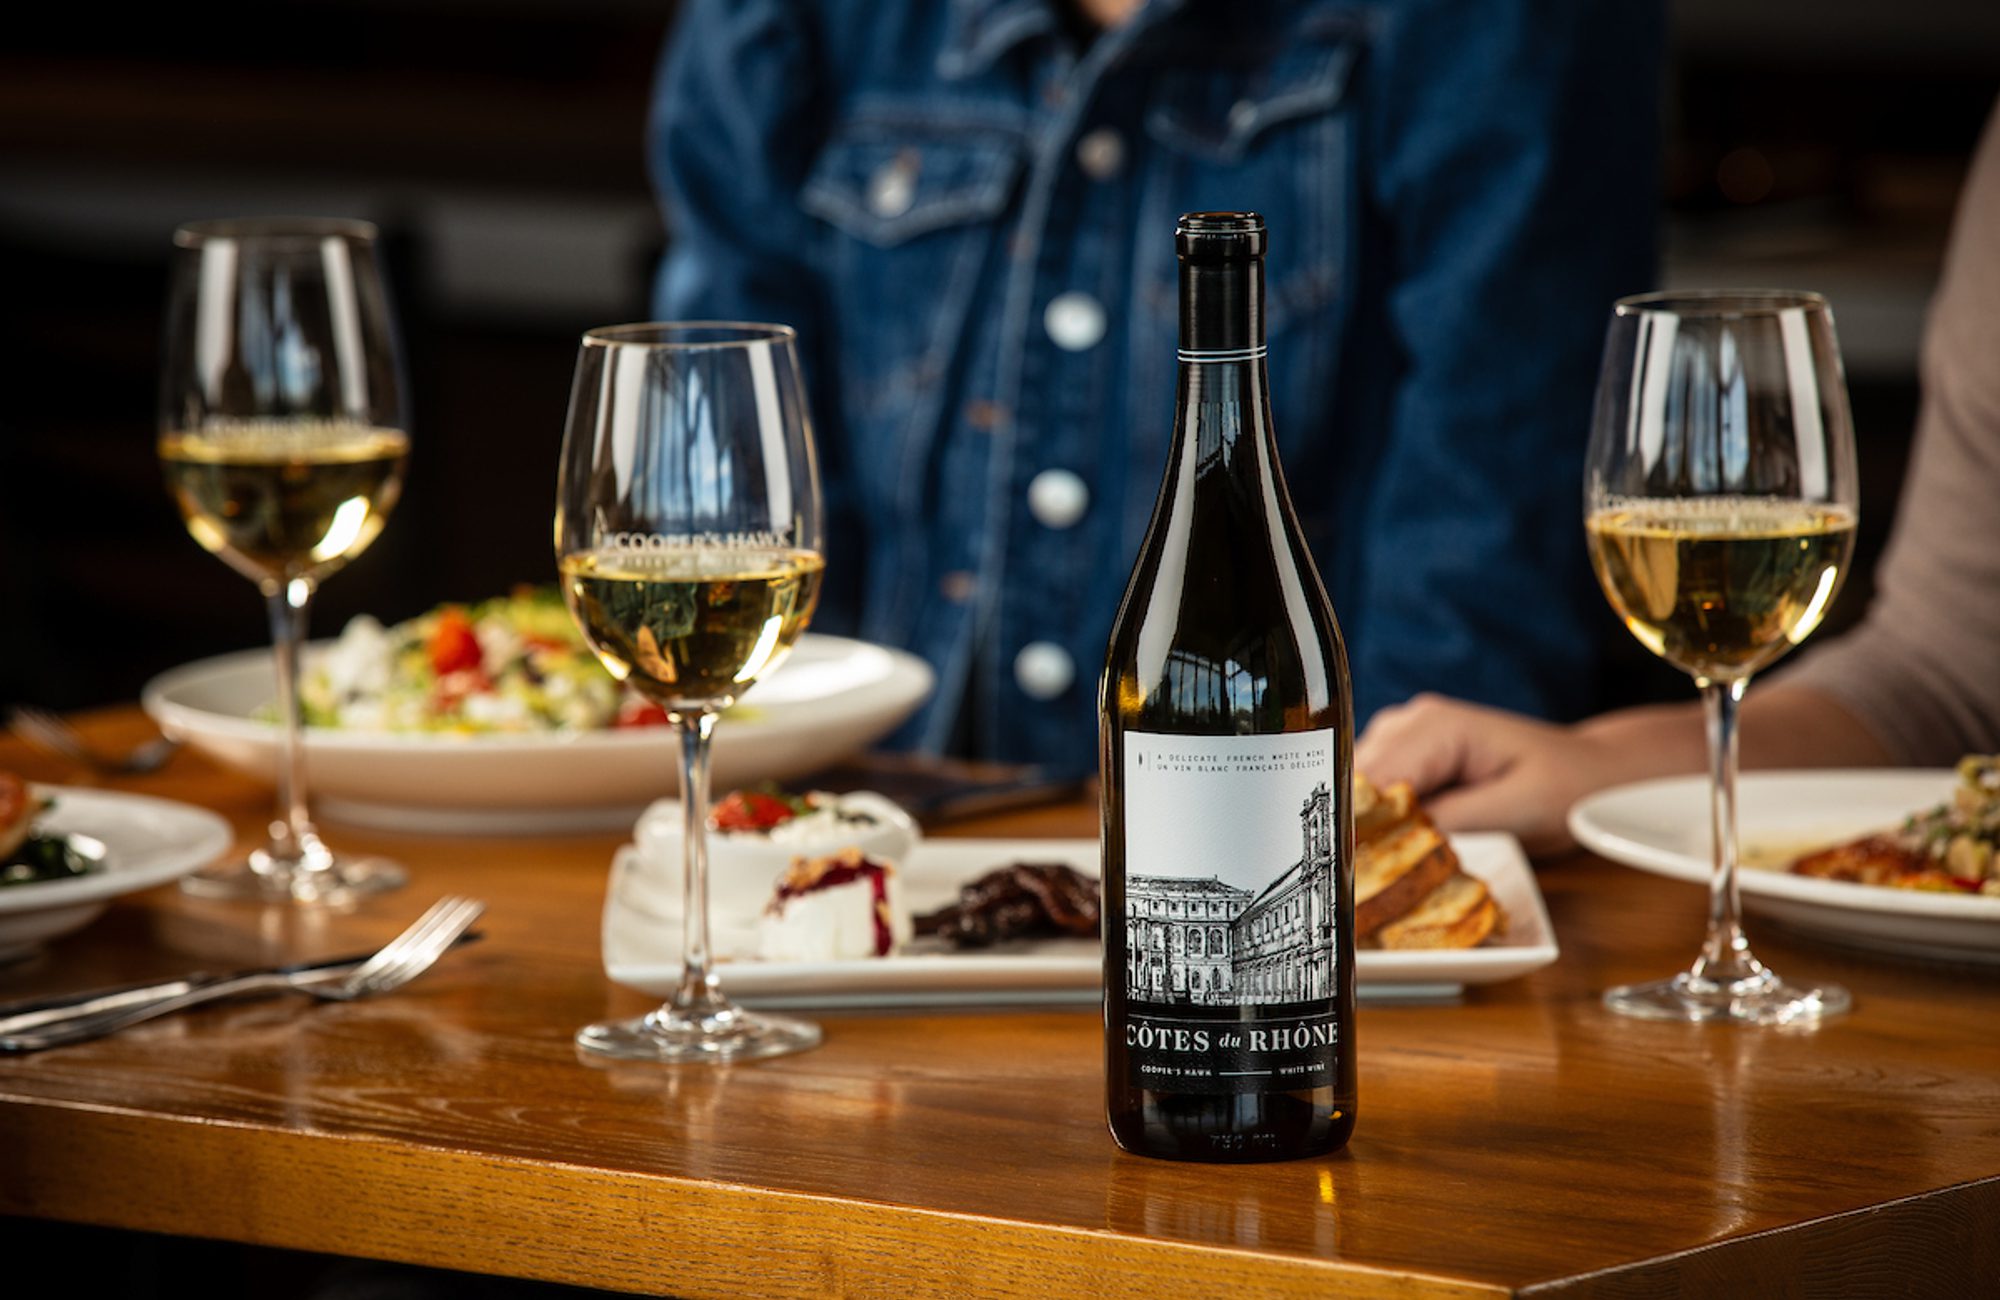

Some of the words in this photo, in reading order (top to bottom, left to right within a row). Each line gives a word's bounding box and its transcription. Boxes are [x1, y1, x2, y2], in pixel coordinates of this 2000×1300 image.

[1169, 754, 1217, 762] DELICATE
[1272, 752, 1300, 760] WHITE
[1306, 749, 1325, 758] WINE
[1236, 763, 1285, 773] FRANÇAIS
[1290, 758, 1325, 770] DÉLICAT
[1127, 1021, 1210, 1052] CÔTES
[1218, 1032, 1242, 1048] du
[1249, 1021, 1338, 1052] RHÔNE
[1141, 1064, 1181, 1076] COOPER'S
[1184, 1068, 1213, 1076] HAWK
[1279, 1066, 1304, 1075] WHITE
[1307, 1062, 1326, 1072] WINE
